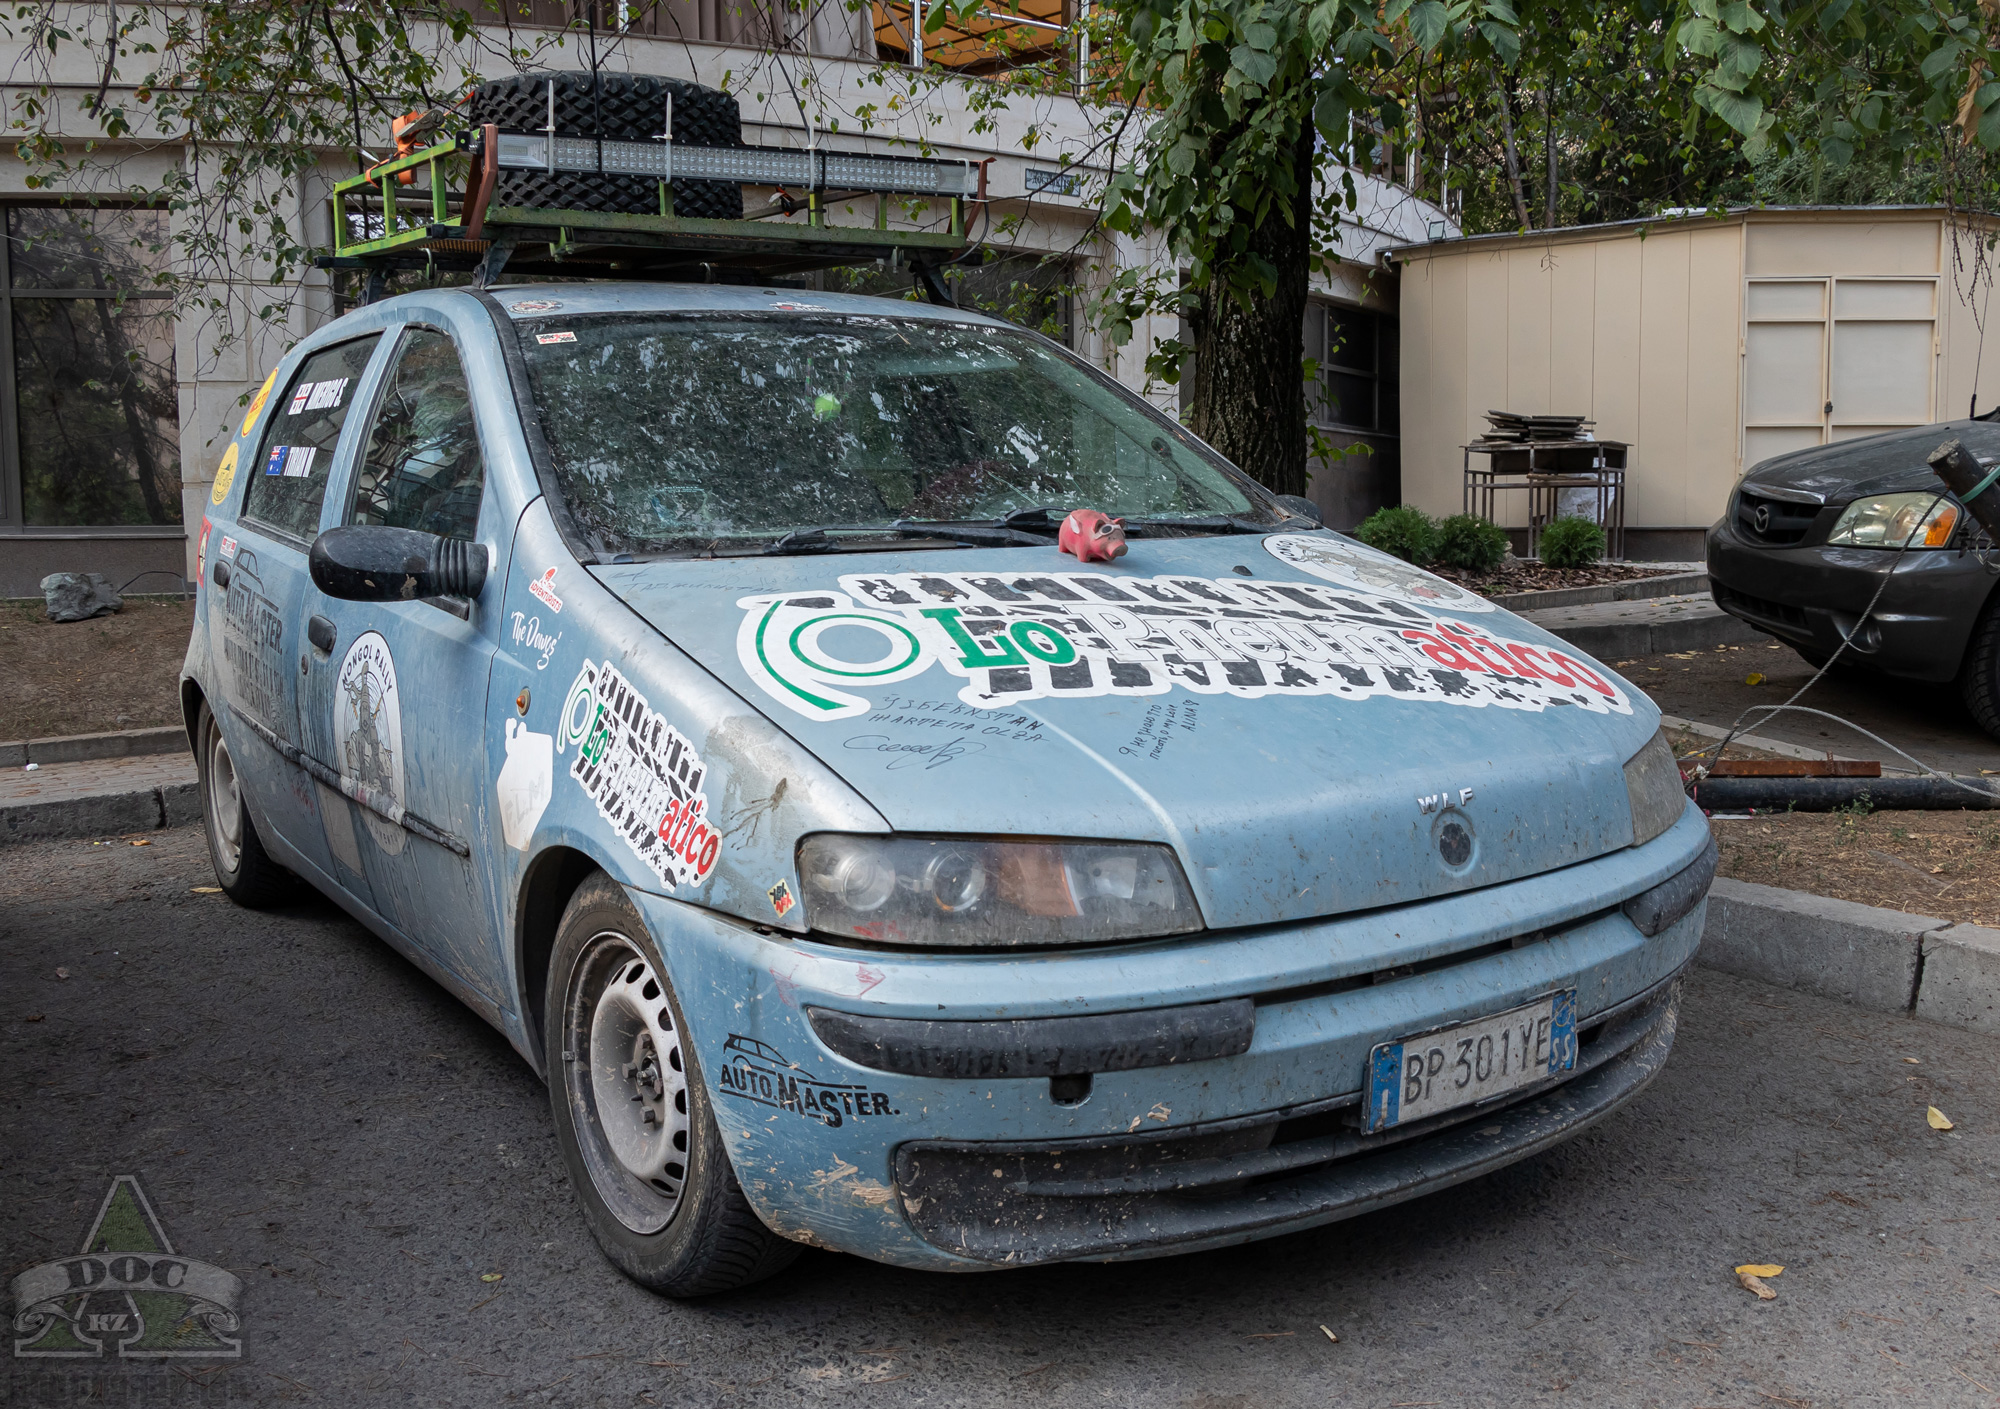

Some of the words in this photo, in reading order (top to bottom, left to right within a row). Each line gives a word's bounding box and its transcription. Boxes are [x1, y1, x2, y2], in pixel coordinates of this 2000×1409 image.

[530, 582, 562, 612] ADVENTURISTS
[342, 644, 372, 686] MONGOL
[374, 648, 393, 693] RALLY
[1403, 1046, 1445, 1106] BP
[1551, 1033, 1571, 1067] SS
